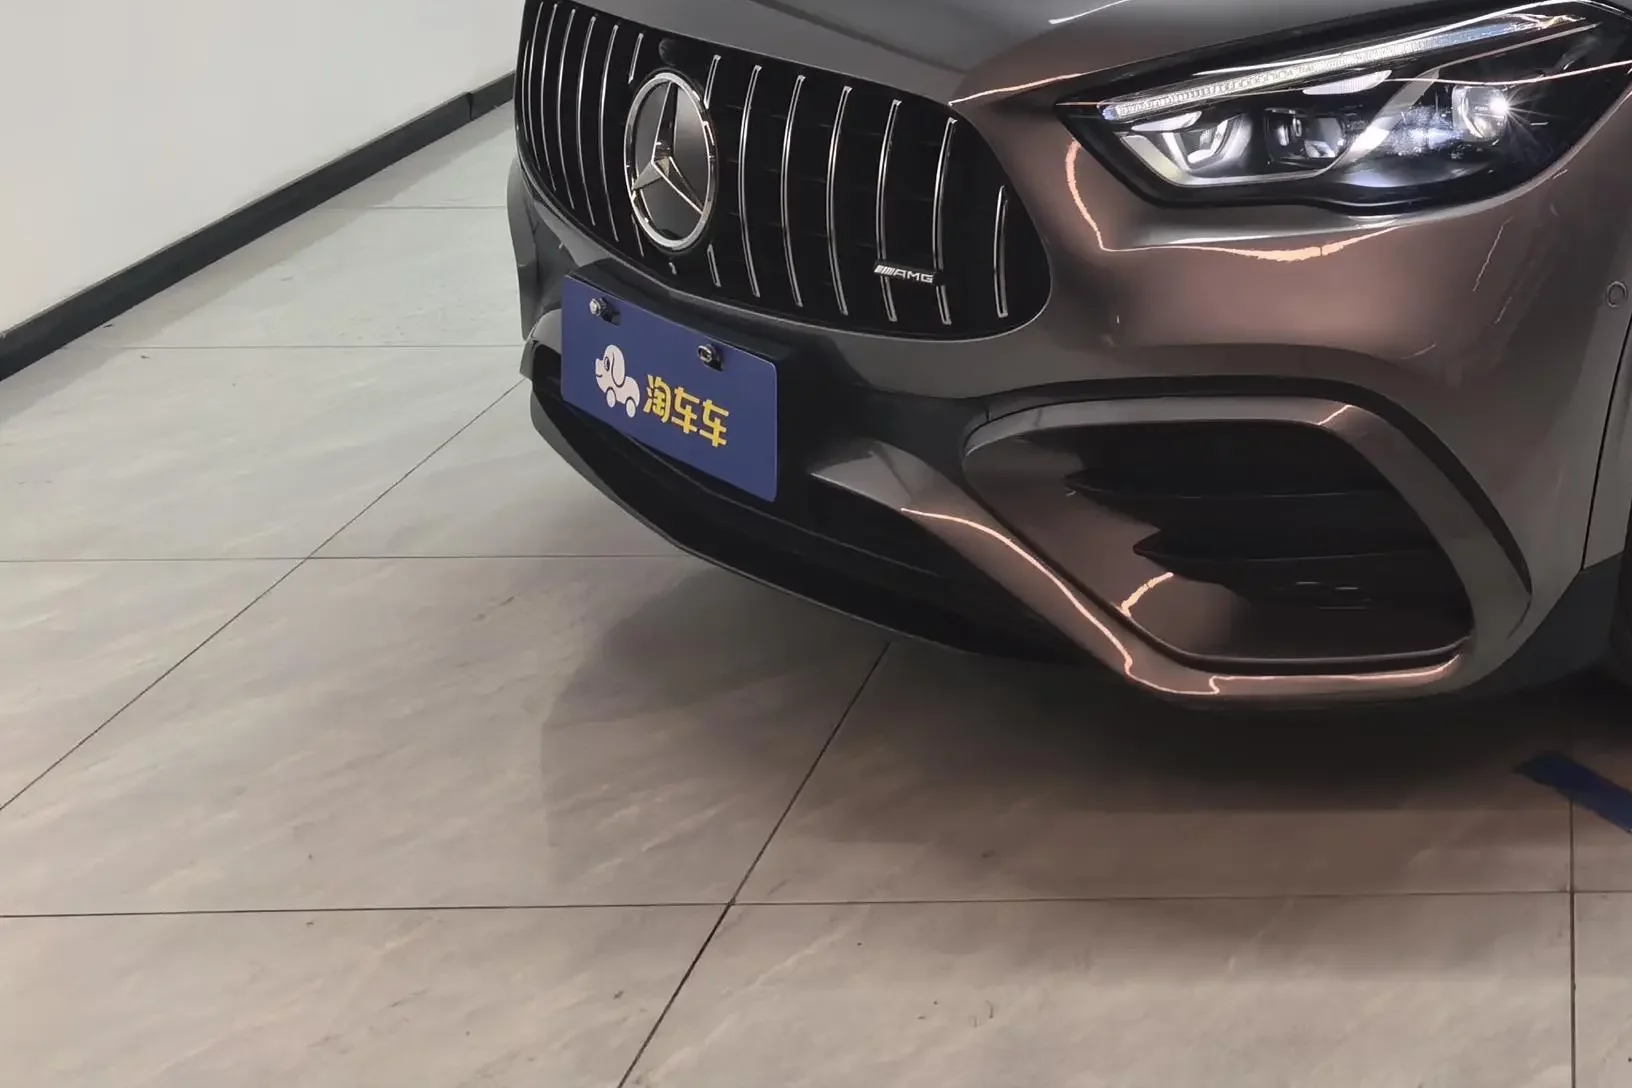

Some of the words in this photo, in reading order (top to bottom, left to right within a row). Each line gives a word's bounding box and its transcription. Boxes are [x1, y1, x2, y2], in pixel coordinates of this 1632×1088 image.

[891, 268, 934, 284] AMG
[643, 374, 730, 447] 淘车车
